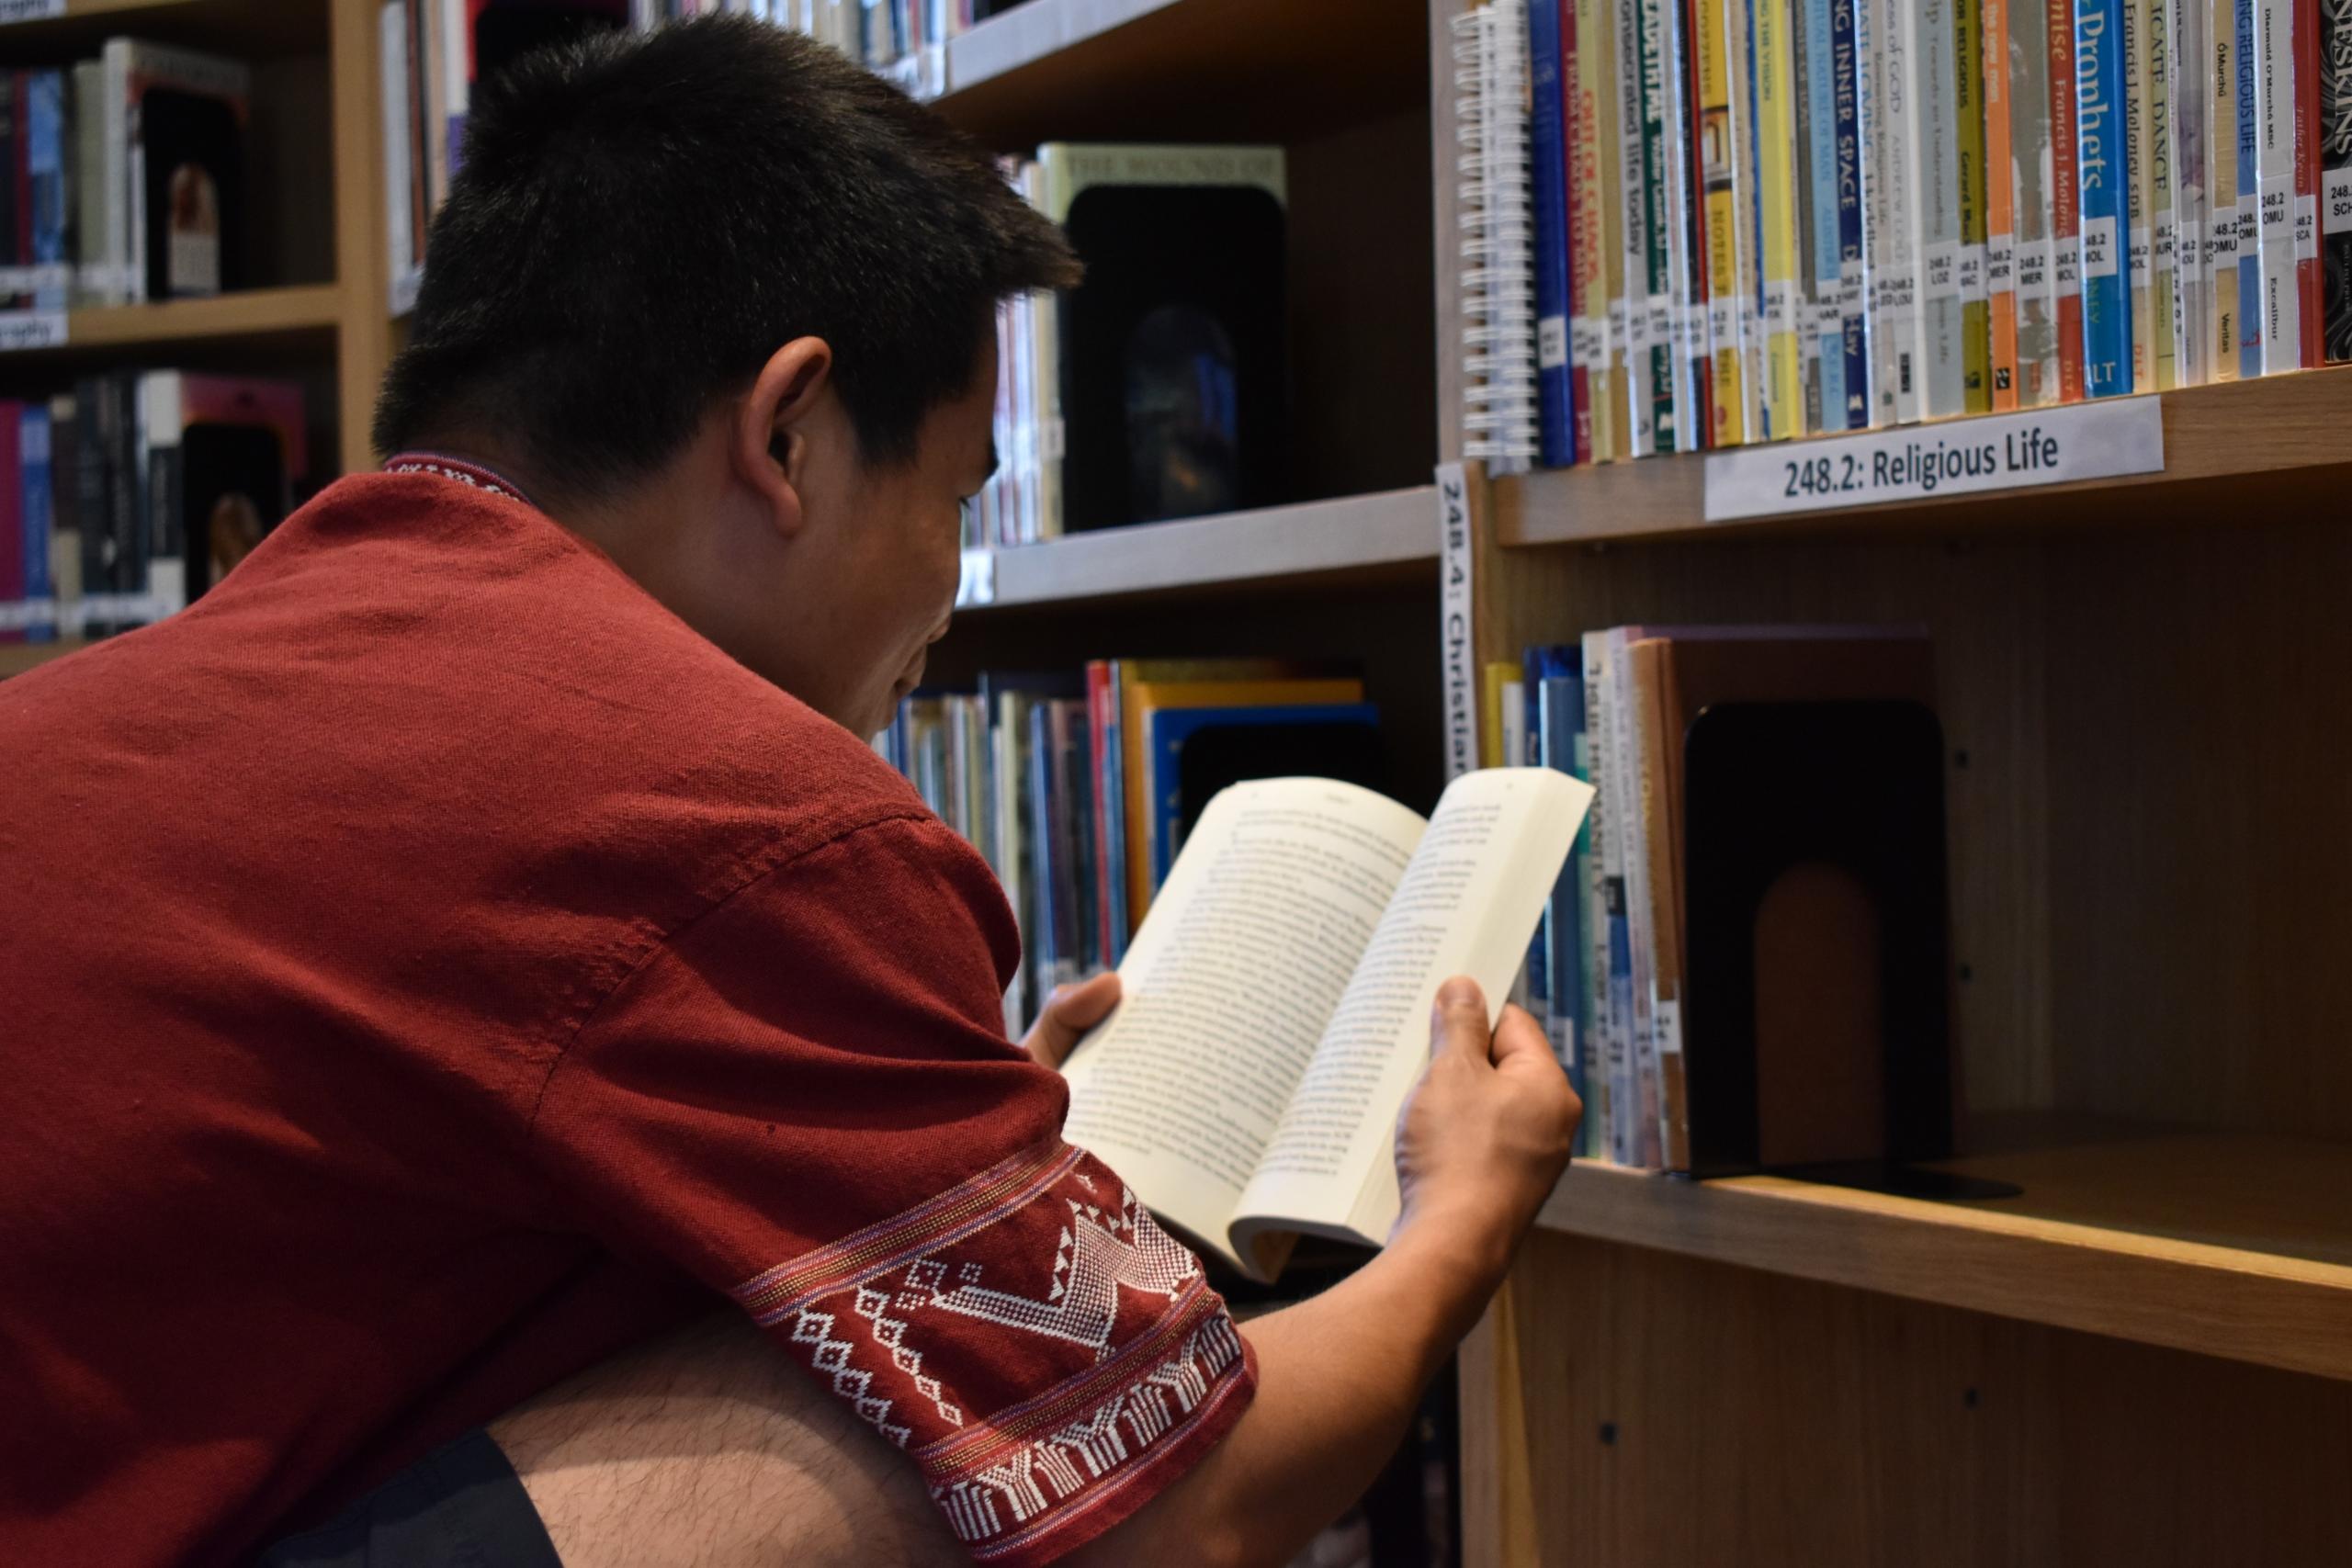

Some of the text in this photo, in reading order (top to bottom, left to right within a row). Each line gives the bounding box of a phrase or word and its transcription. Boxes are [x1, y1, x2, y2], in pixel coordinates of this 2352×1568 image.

[1957, 26, 1969, 109] RELIGIOUS
[1986, 3, 2000, 104] the new man
[2124, 2, 2139, 76] Francis
[2238, 33, 2256, 118] RELIGIOUS
[1836, 43, 1852, 124] INNER
[1890, 61, 1902, 114] GOD
[2055, 78, 2068, 151] Francis
[2075, 9, 2109, 191] Prophets
[1627, 142, 1642, 182] life
[1838, 134, 1856, 210] SPACE
[2127, 97, 2142, 176] Moloney
[2152, 98, 2167, 192] DANCE
[2240, 124, 2256, 155] LIFE
[1628, 186, 1644, 257] today
[2261, 192, 2284, 208] 248.2
[2262, 210, 2284, 225] OMU
[2019, 255, 2045, 270] 248.2
[2020, 272, 2042, 285] MER
[2222, 312, 2231, 354] Veritas
[2269, 276, 2278, 341] Excalibur
[1783, 426, 2059, 499] 248.2: Religious Life
[1443, 480, 1464, 601] 248.4:
